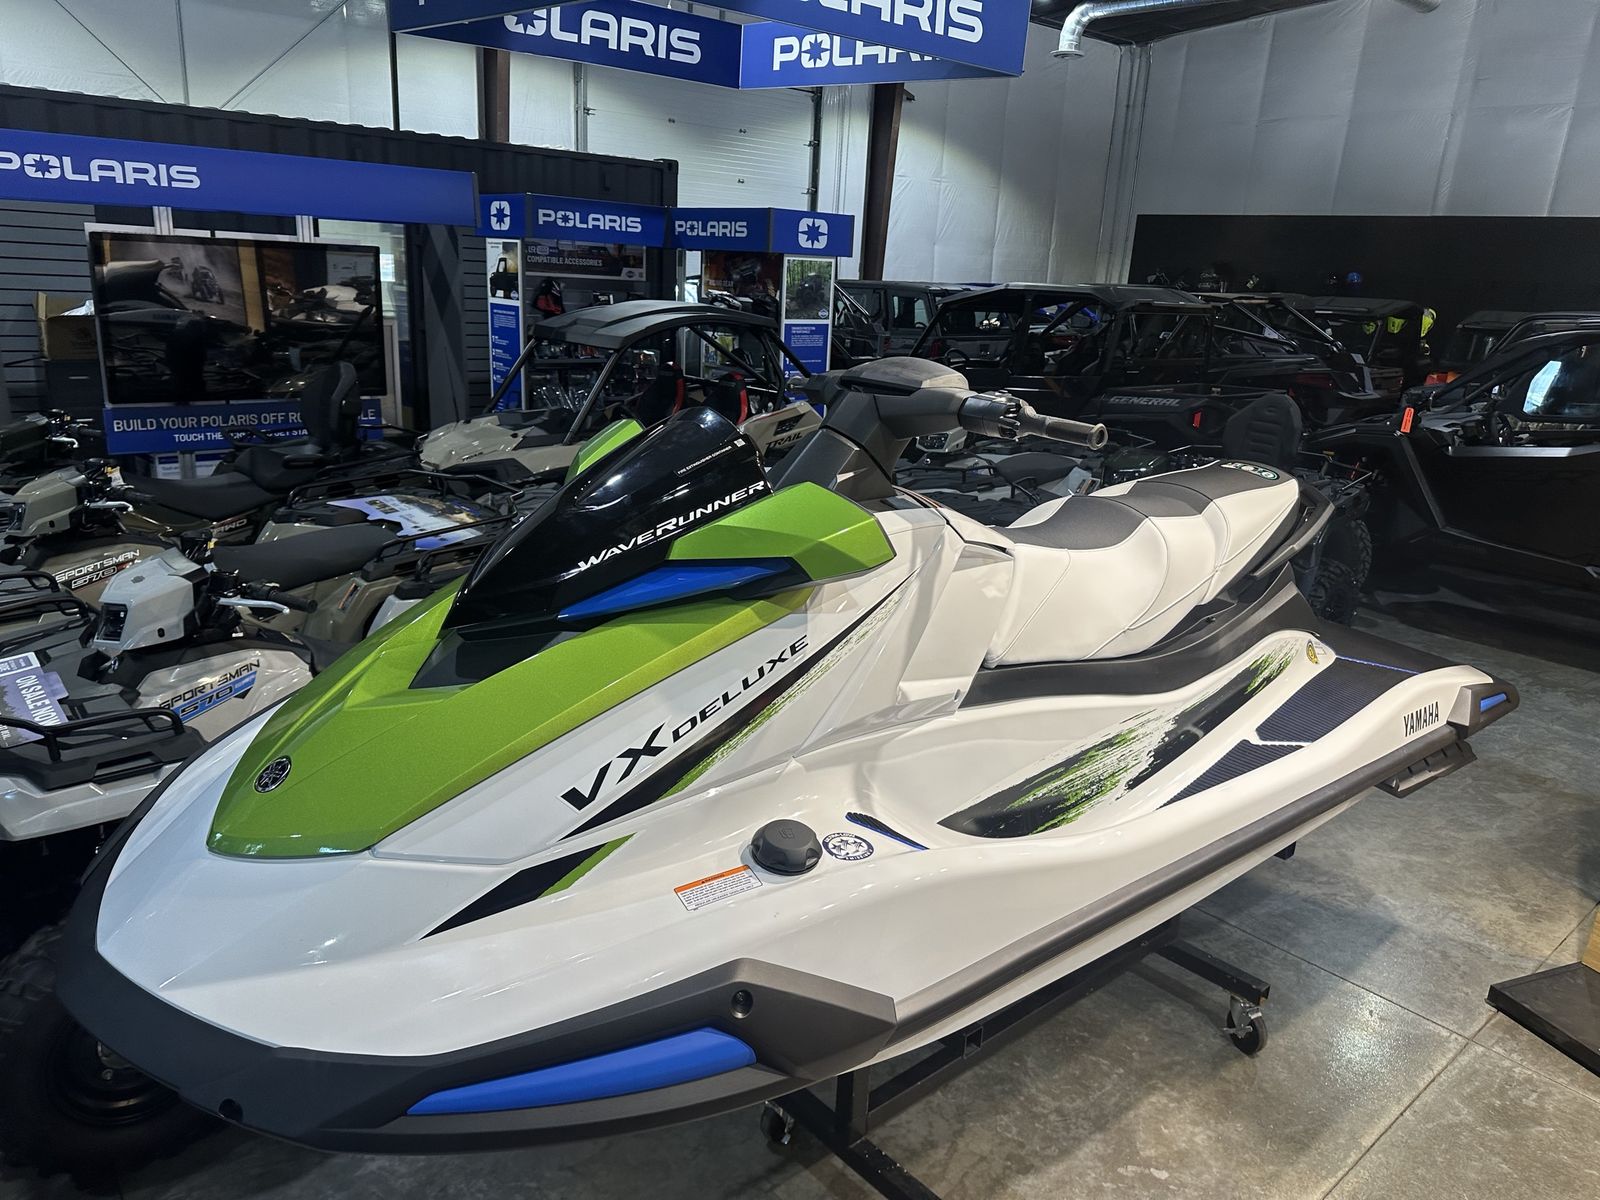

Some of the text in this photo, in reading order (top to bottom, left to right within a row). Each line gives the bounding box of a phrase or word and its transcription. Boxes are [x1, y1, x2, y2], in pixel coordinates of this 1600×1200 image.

[464, 7, 701, 64] OLARIS
[538, 208, 642, 233] POLARIS
[675, 220, 747, 237] POLARIS
[527, 255, 563, 265] COMPATIBLE
[1108, 396, 1181, 407] GENERAL
[113, 419, 157, 432] BUILD
[160, 416, 197, 430] YOUR
[201, 414, 258, 427] POLARIS
[261, 413, 285, 424] OFF
[173, 433, 204, 442] TOUCH
[206, 432, 224, 440] THE
[765, 432, 802, 447] TRAIL
[55, 549, 140, 583] SPORTSMAN
[72, 566, 118, 589] 570
[159, 658, 260, 709] SPORTSMAN
[20, 685, 51, 710] SALE
[180, 685, 233, 717] 570
[560, 634, 808, 811] VX DELUXE
[1404, 701, 1439, 737] YAMAHA
